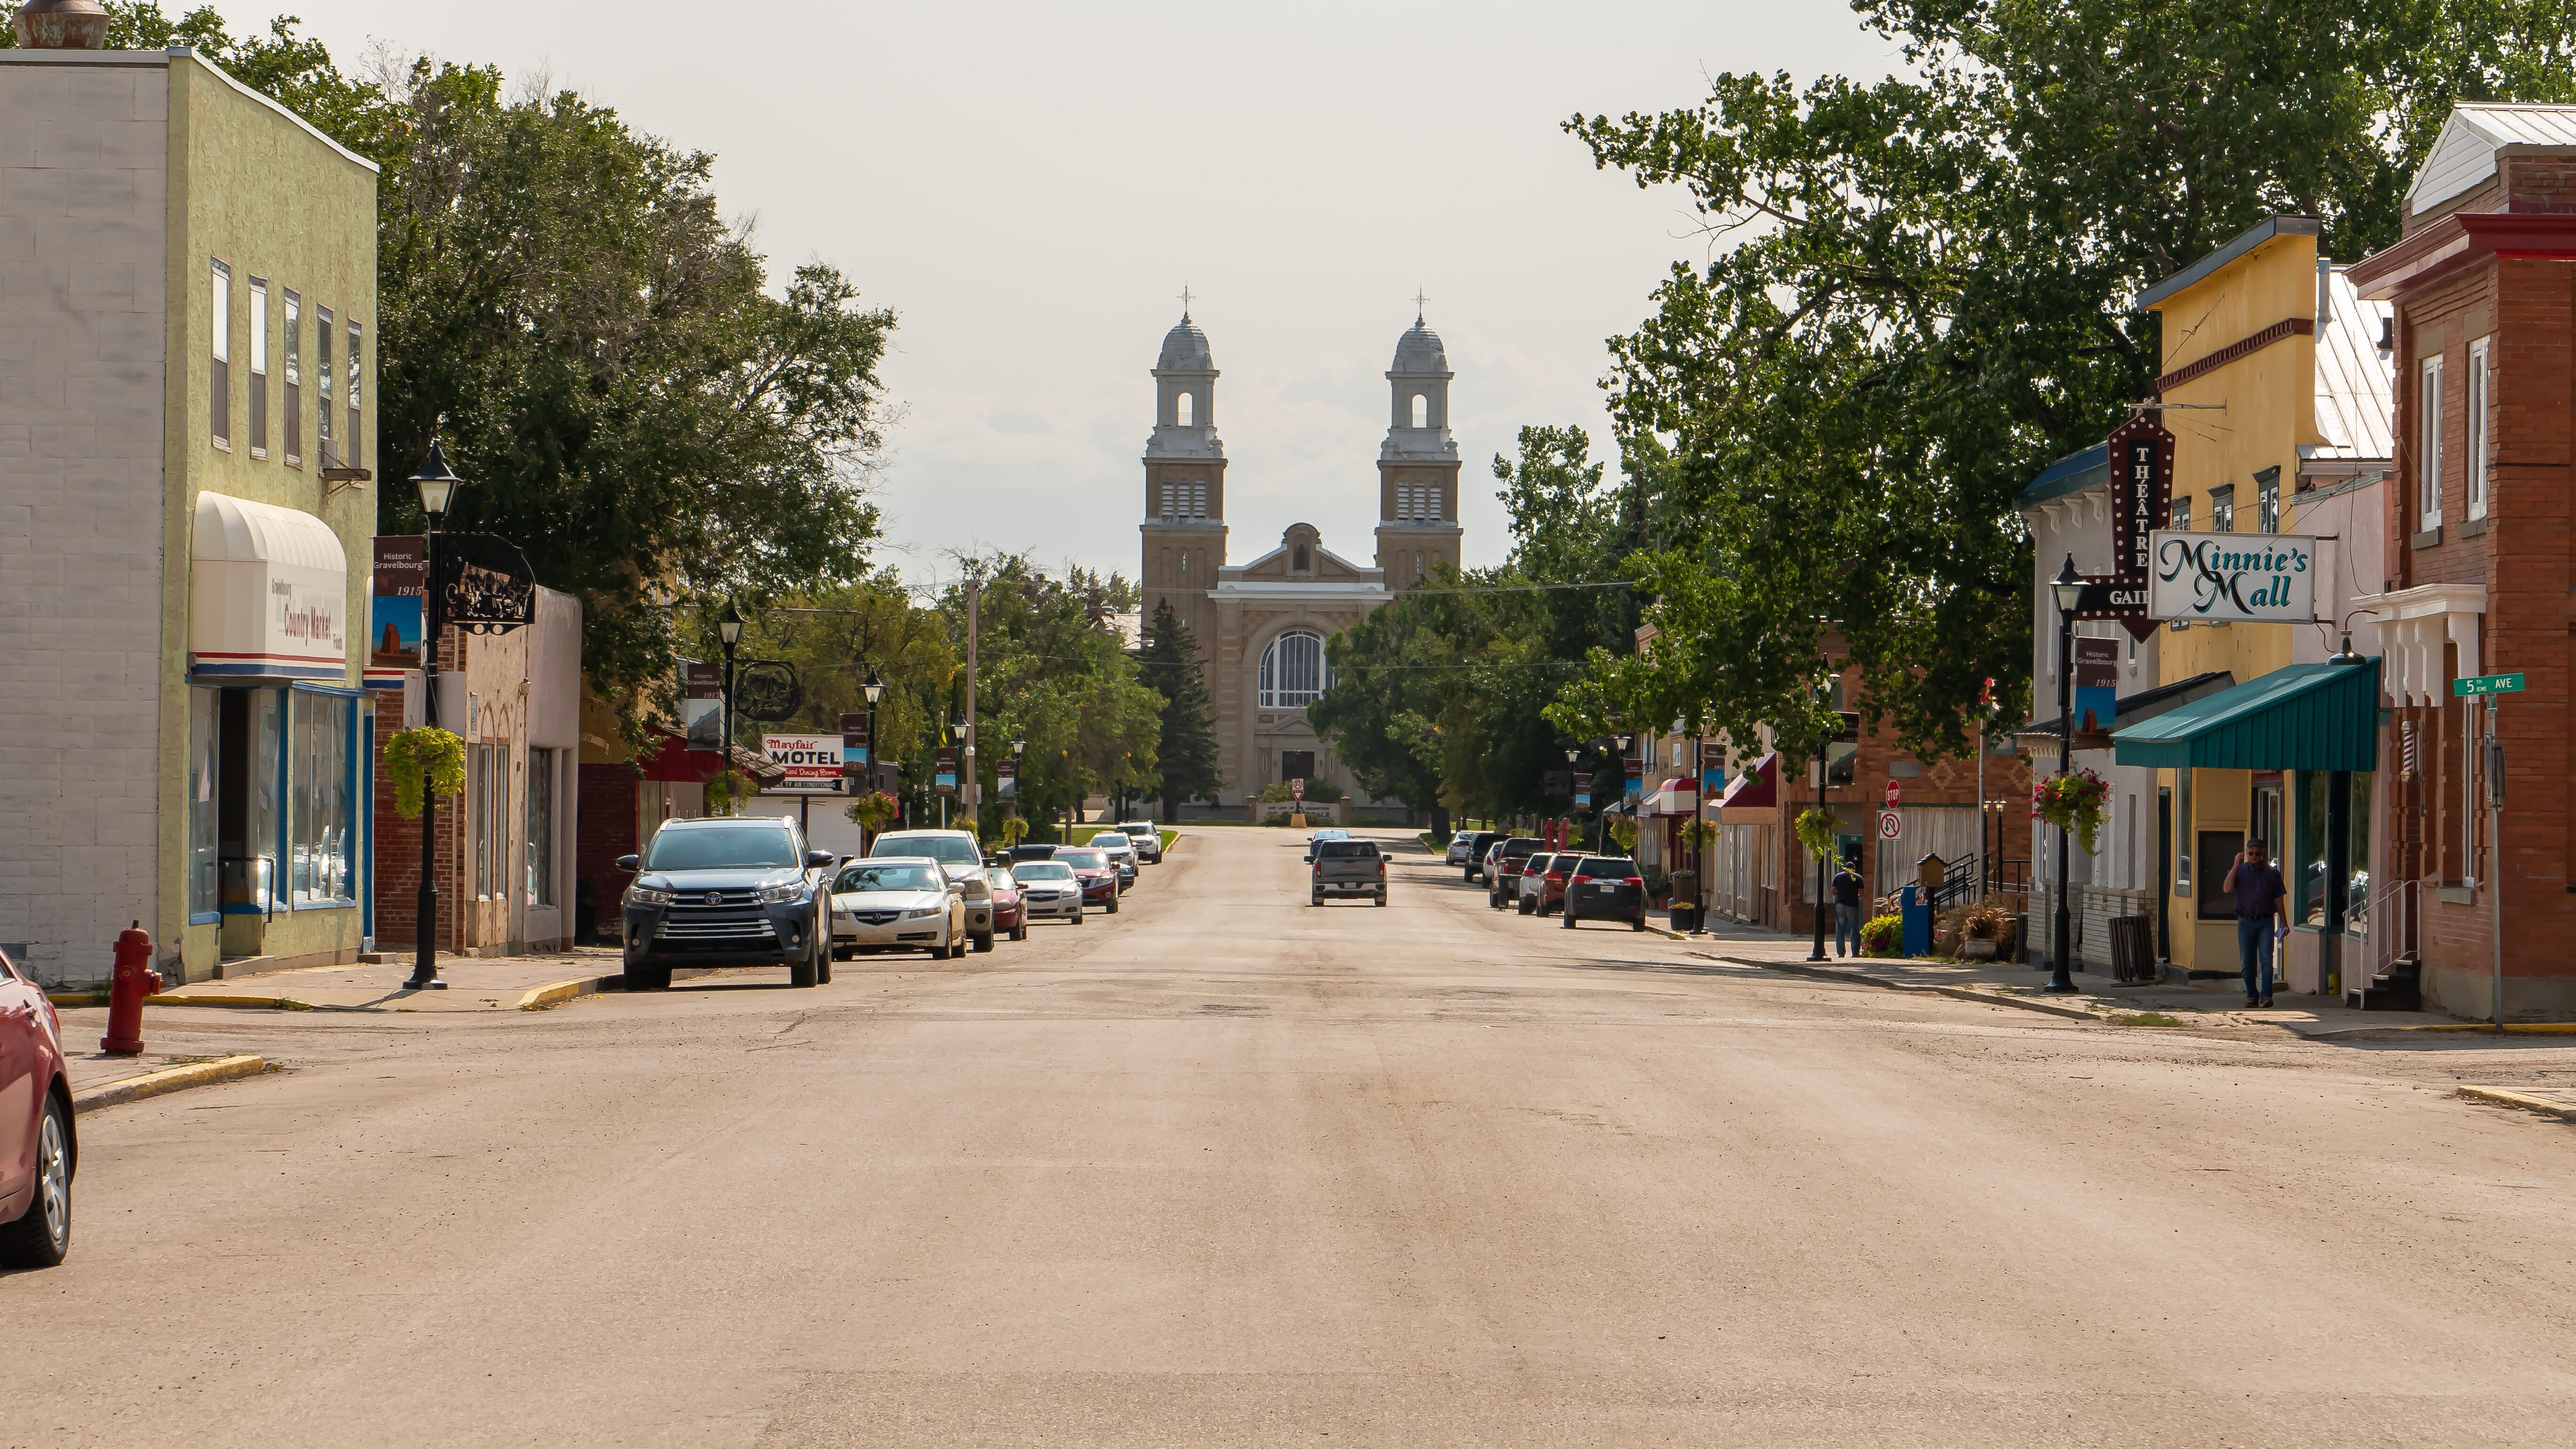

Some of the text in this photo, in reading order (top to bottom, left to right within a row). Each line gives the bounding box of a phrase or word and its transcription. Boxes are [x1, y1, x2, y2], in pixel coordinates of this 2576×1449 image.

[2134, 447, 2150, 567] THÉÂTRE
[374, 561, 423, 571] Gravelbourg
[2159, 539, 2308, 583] Minnie's
[397, 586, 423, 596] 1915
[2193, 570, 2292, 616] Mall
[284, 603, 309, 647] Country
[311, 606, 331, 641] Market
[2077, 658, 2117, 667] Gravelbourg
[2095, 679, 2116, 687] 1915
[2466, 680, 2475, 693] 5
[2495, 678, 2513, 689] AVE
[766, 739, 818, 751] Mayfair
[772, 751, 840, 765] MOTEL
[799, 768, 819, 777] Dining
[1887, 789, 1899, 801] STOP
